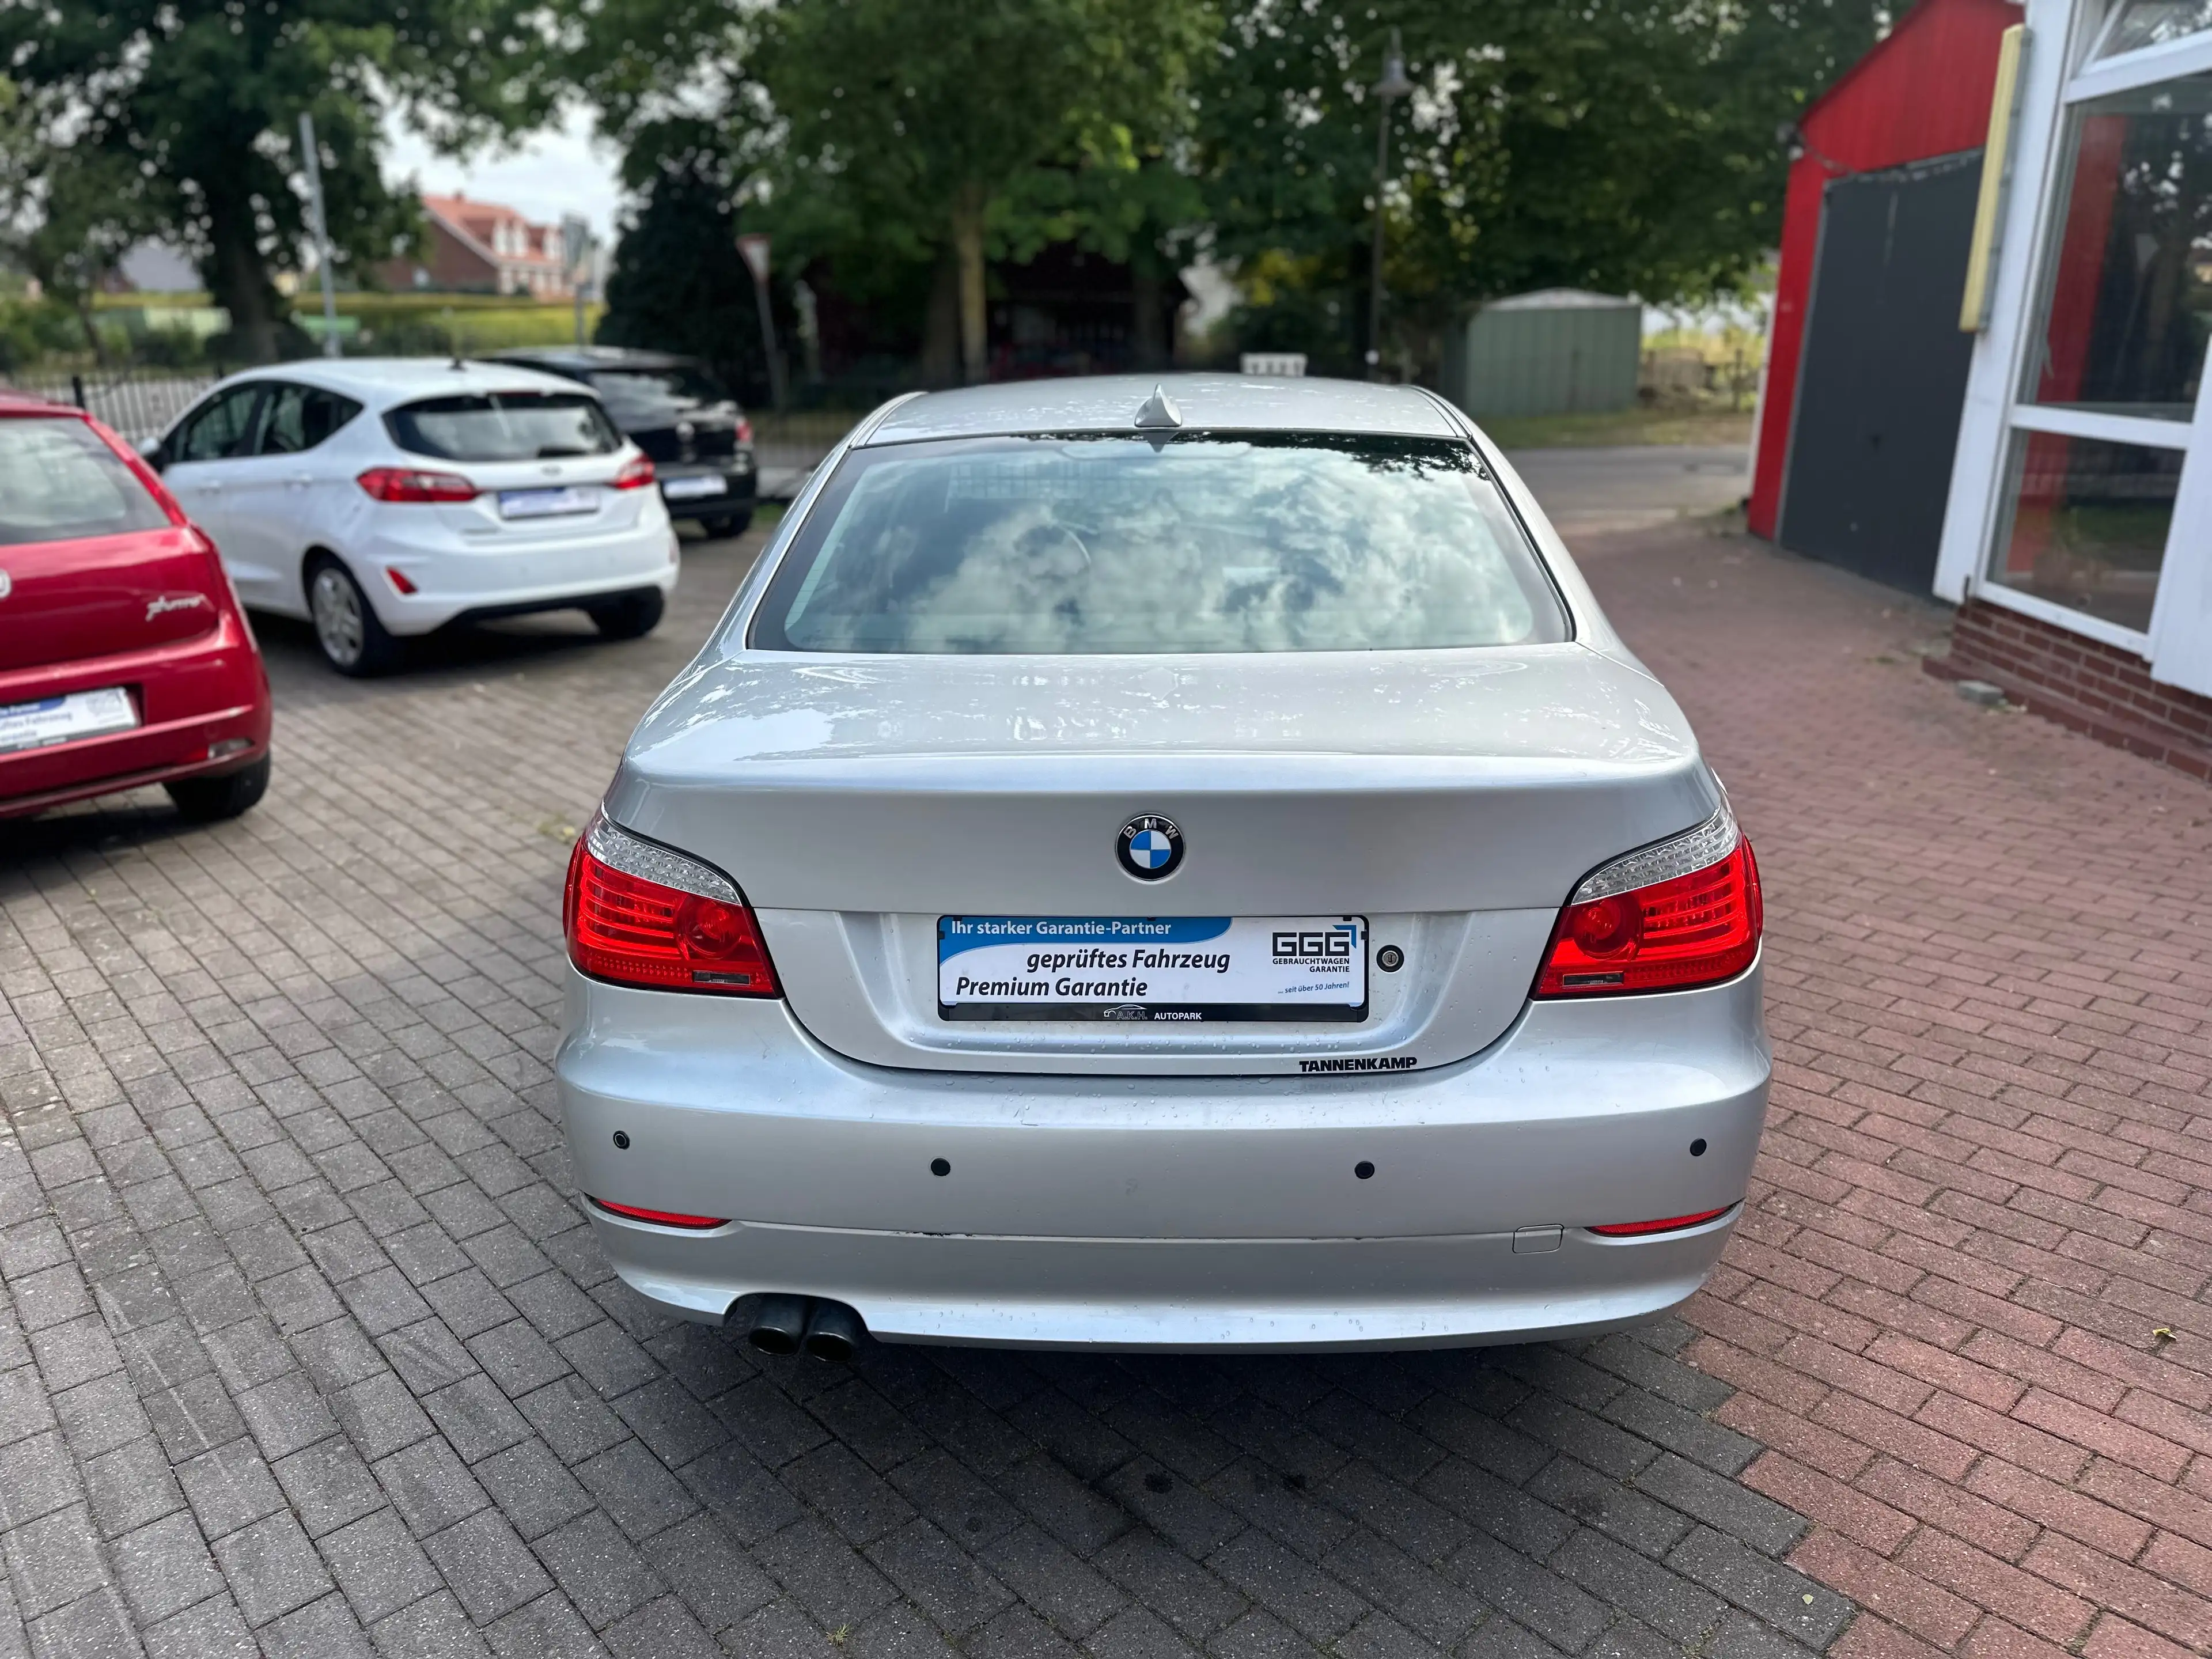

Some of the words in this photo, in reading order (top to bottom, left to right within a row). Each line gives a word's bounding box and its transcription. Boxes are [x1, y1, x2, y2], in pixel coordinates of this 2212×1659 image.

[1123, 818, 1179, 839] BMW
[952, 921, 973, 934] Ihr
[977, 921, 1032, 934] starker
[1036, 921, 1171, 935] Garantie-Partner
[1272, 932, 1349, 956] GGG
[1027, 949, 1127, 973] geprüftes
[1132, 949, 1230, 974] Fahrzeug
[956, 977, 1049, 995] Premium
[1055, 977, 1147, 996] Garantie
[1324, 981, 1350, 990] Jahren!
[1299, 1056, 1417, 1072] TANNENKAMP
